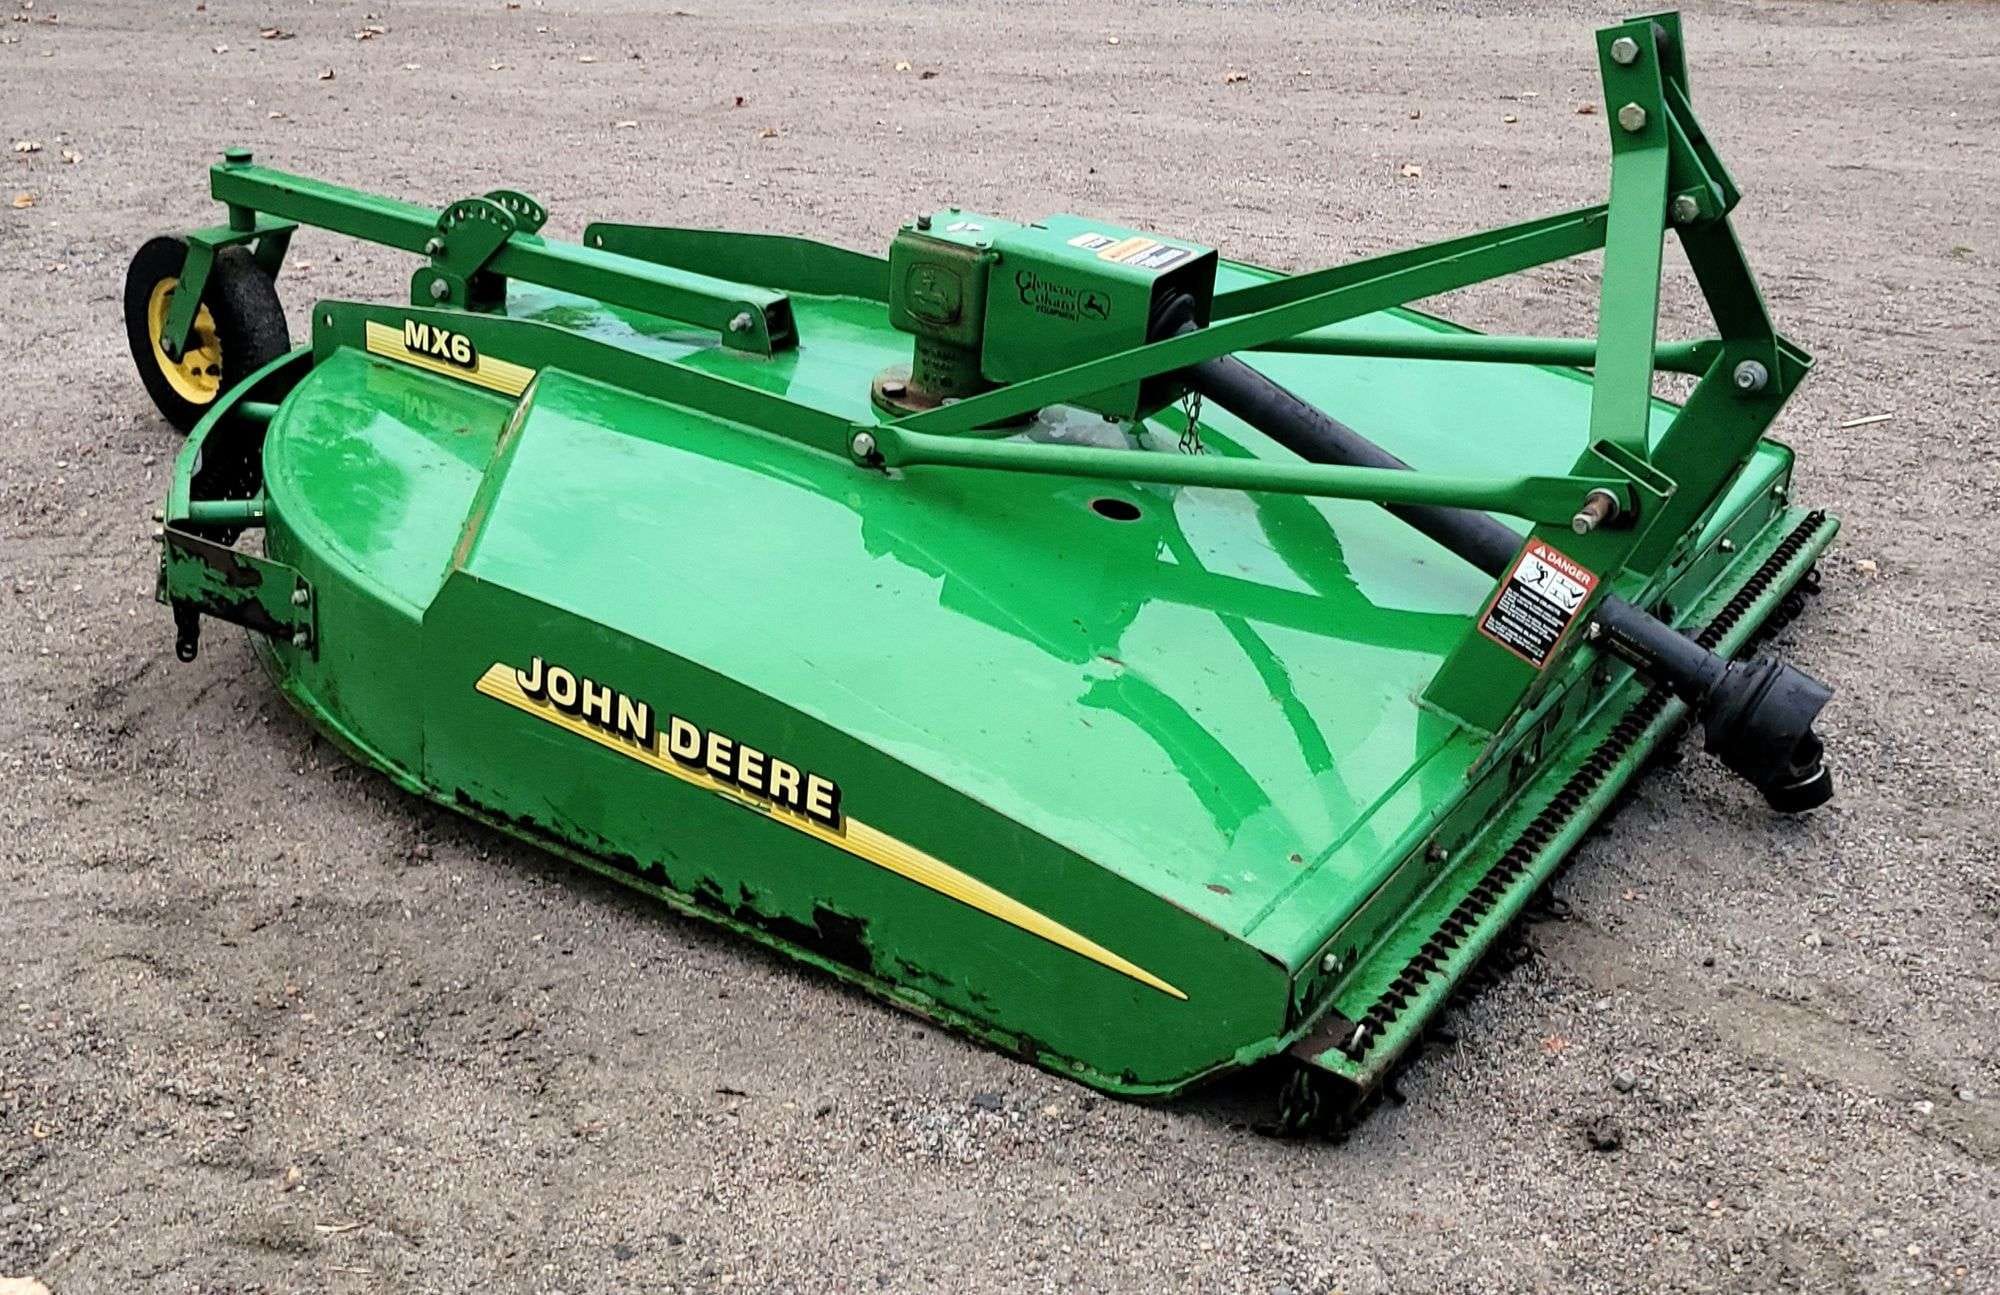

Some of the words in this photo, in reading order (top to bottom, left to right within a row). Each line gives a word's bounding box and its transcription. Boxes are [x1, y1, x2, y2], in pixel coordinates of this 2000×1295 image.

[404, 318, 474, 366] MX6
[1546, 552, 1592, 585] DANGER
[516, 656, 651, 743] JOHN
[669, 714, 837, 824] DEERE
